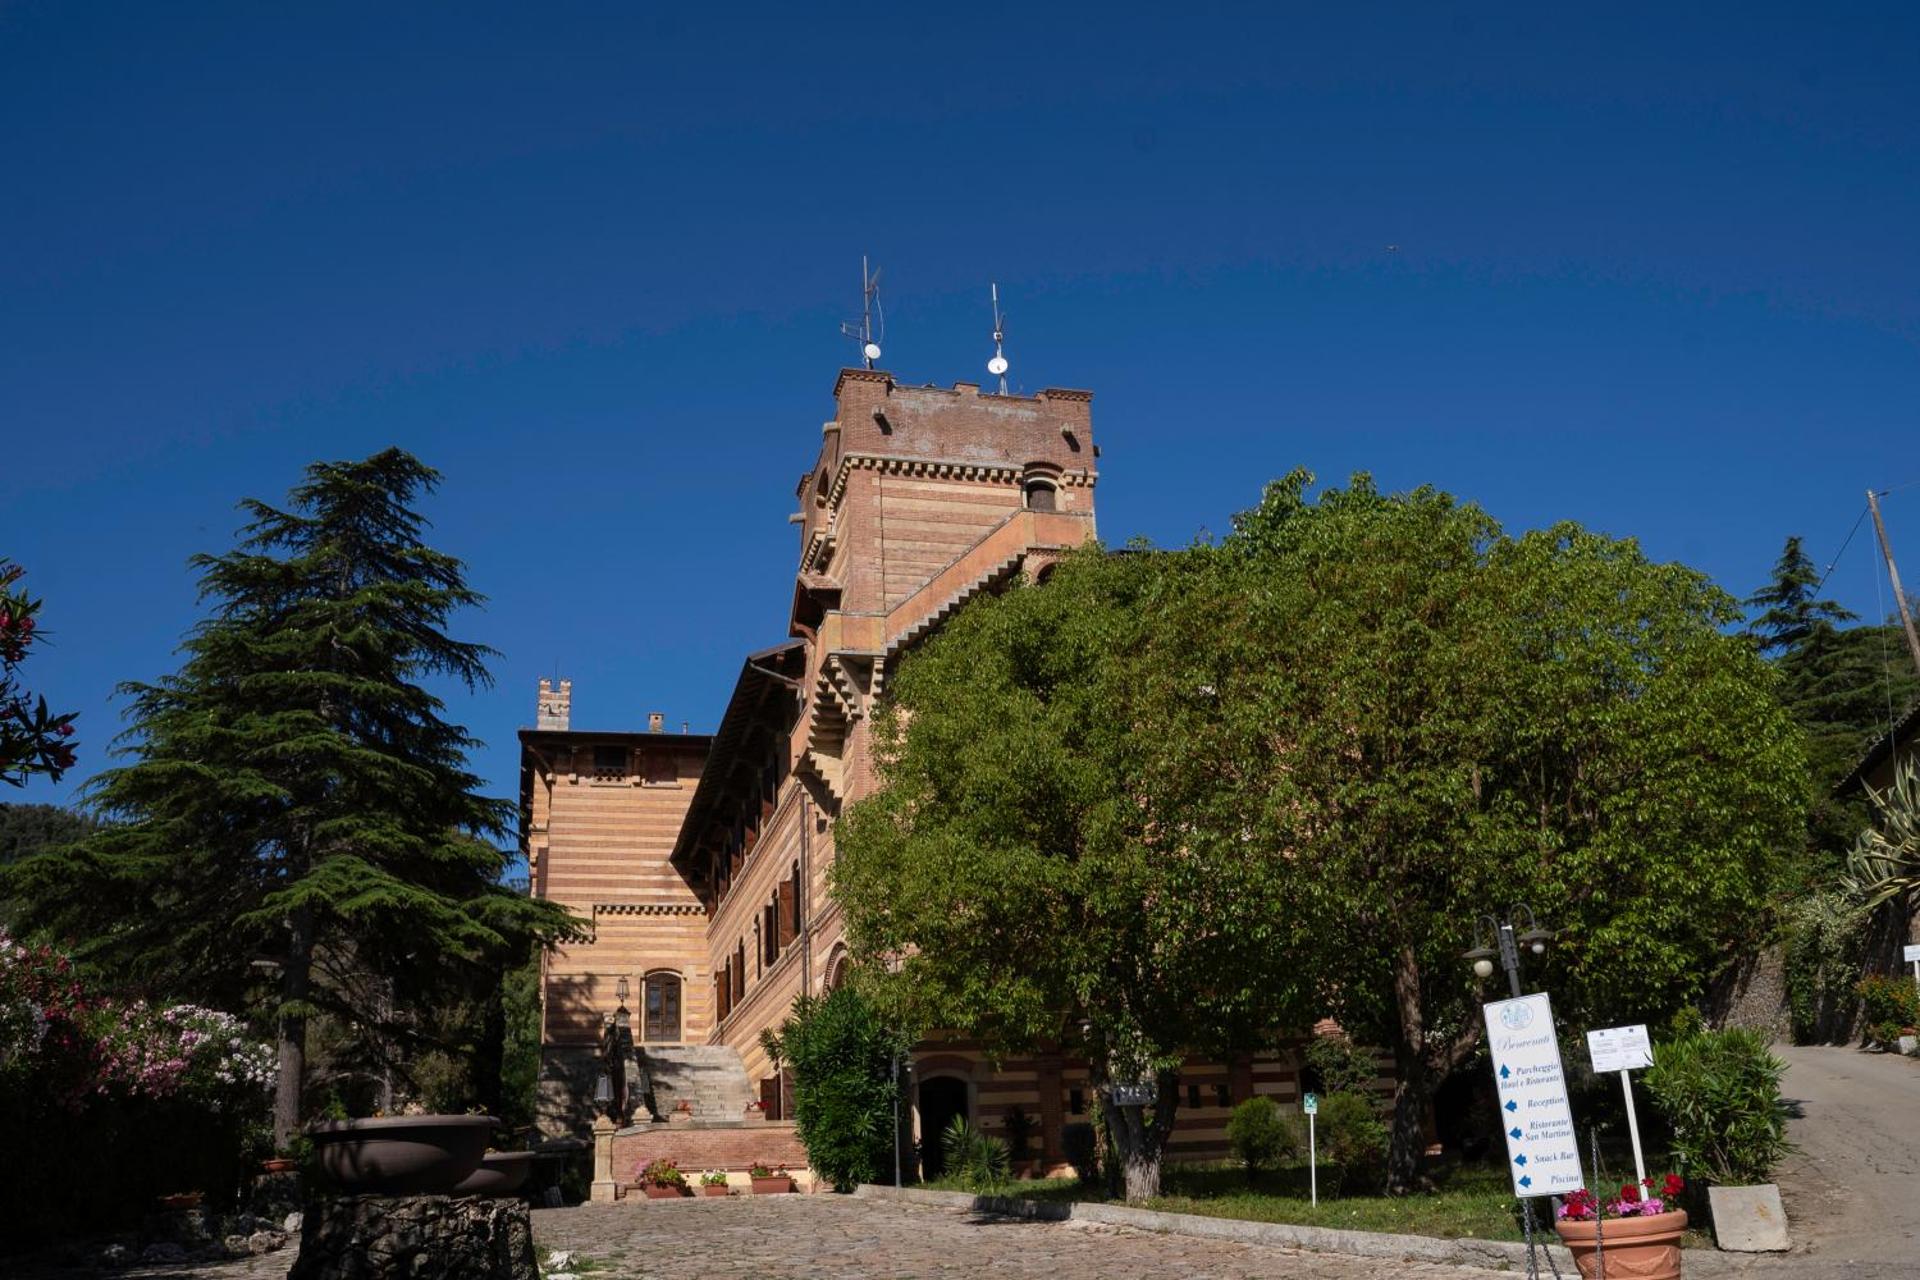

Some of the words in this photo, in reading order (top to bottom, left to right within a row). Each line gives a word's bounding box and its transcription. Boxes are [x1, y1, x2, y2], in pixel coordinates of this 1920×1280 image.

[1516, 1064, 1559, 1075] Parcheggio
[1526, 1075, 1559, 1086] Ristorante
[1527, 1097, 1565, 1108] Reception
[1530, 1119, 1569, 1130] Ristorante
[1525, 1133, 1540, 1142] San
[1541, 1130, 1571, 1139] Martino
[1535, 1152, 1557, 1164] Snack
[1560, 1151, 1575, 1161] Bar
[1551, 1174, 1579, 1185] Piscina
